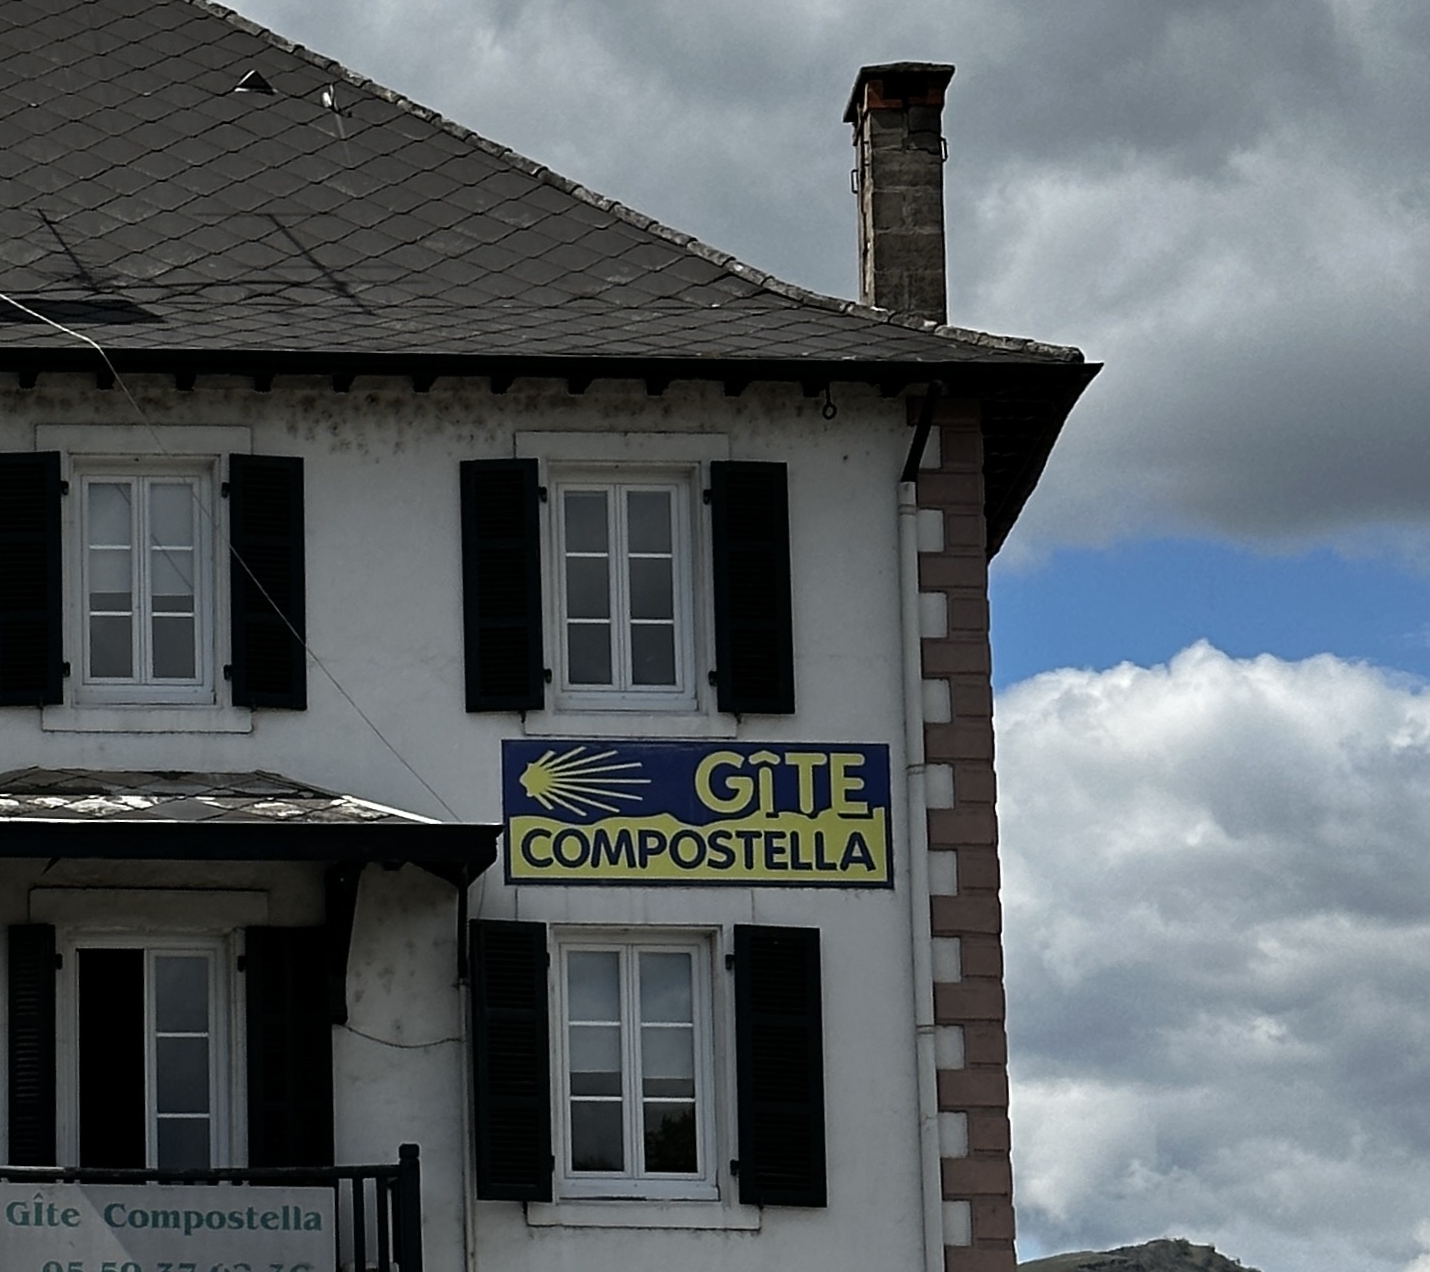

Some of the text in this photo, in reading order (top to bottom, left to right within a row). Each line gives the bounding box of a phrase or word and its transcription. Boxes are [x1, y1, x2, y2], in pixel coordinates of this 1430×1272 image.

[695, 750, 870, 815] GÎTE
[521, 828, 876, 871] COMPOSTELLA
[104, 1203, 322, 1235] Compostella
